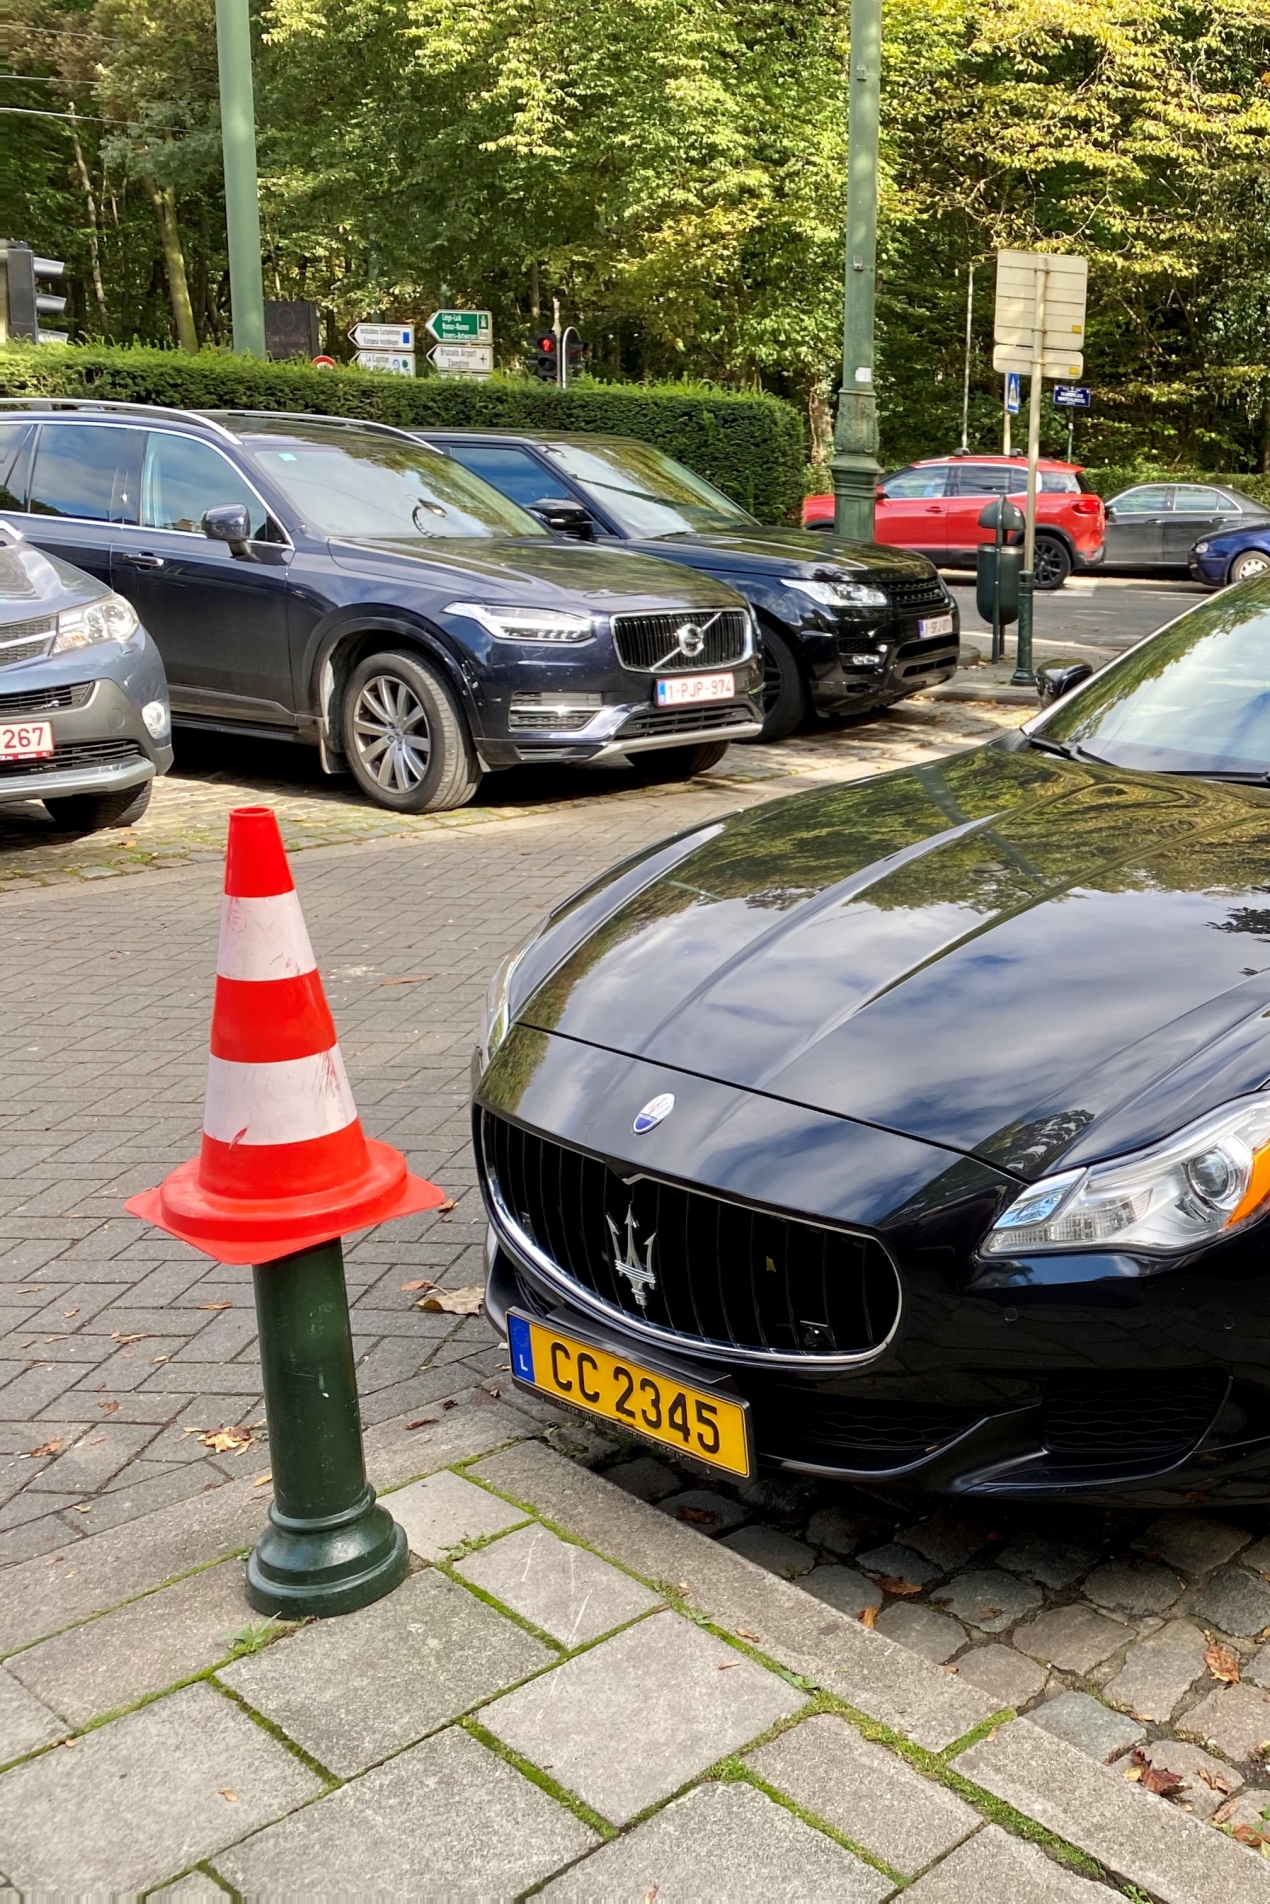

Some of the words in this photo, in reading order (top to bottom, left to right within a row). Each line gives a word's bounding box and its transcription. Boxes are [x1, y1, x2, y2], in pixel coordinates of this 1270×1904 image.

[440, 347, 460, 356] Brussels
[460, 348, 477, 359] Airport
[447, 358, 470, 368] Zaventem
[668, 679, 732, 701] 1-PJP-974
[2, 726, 44, 749] 267
[518, 1353, 529, 1372] L
[550, 1340, 600, 1403] CC
[612, 1364, 721, 1455] 2345
